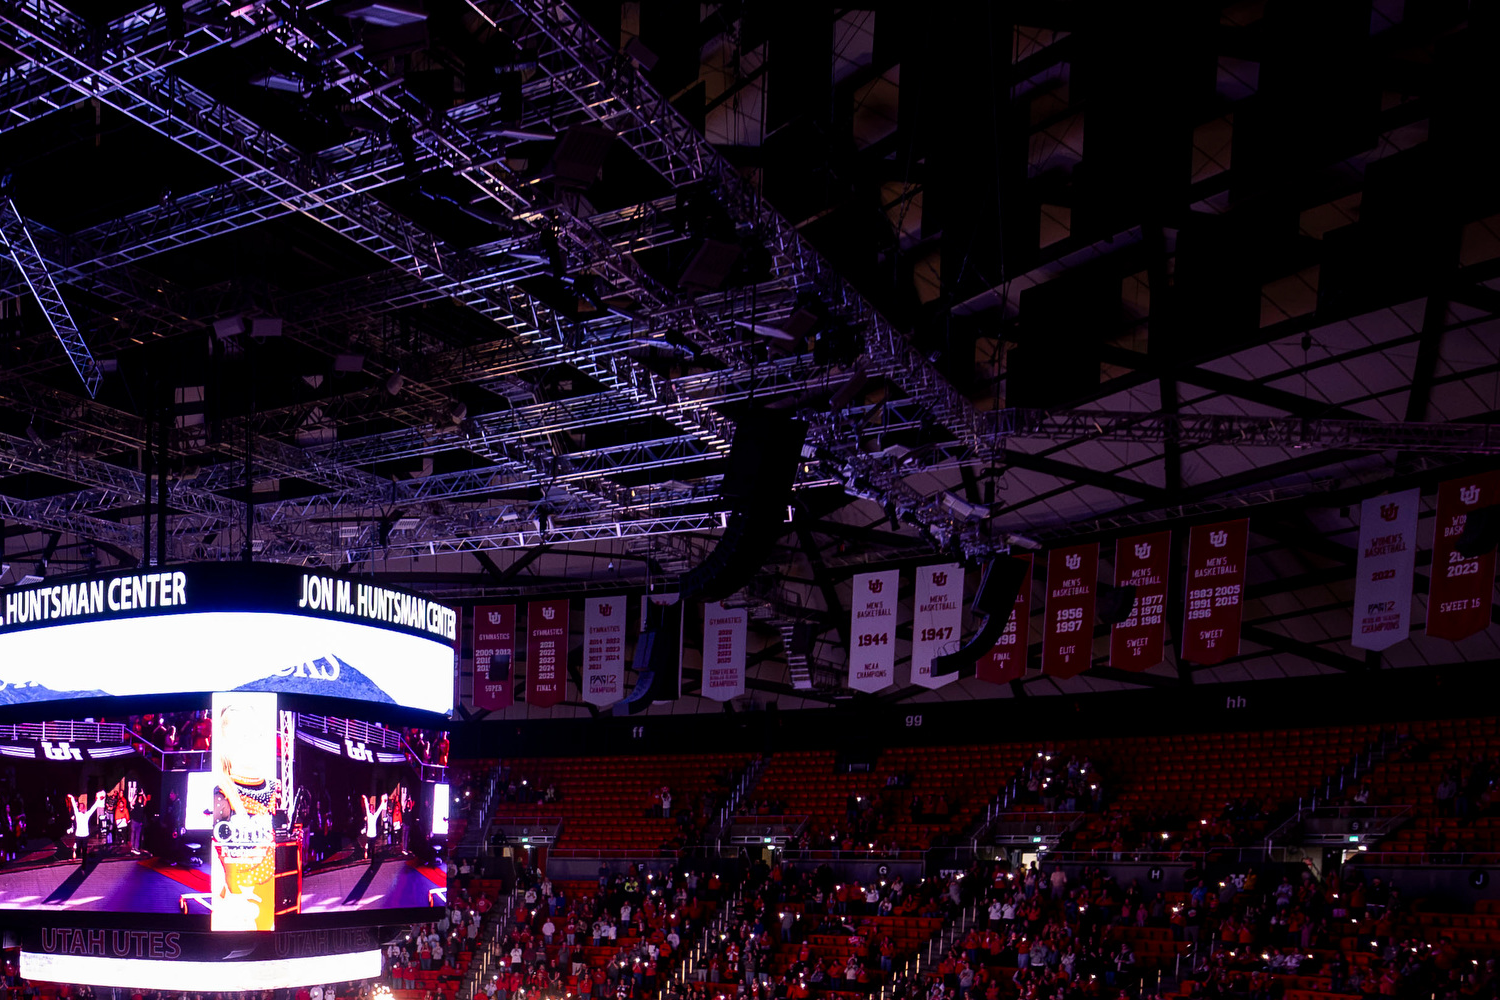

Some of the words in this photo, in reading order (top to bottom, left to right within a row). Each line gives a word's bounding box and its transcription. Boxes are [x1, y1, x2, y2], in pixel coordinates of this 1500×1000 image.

[1371, 533, 1402, 547] WOMEN'S
[1364, 543, 1407, 558] BASKETBALL
[1206, 556, 1228, 567] MEN'S
[1131, 568, 1152, 578] MEN'S
[1194, 564, 1238, 578] BASKETBALL
[1371, 569, 1395, 581] 2023
[1446, 562, 1479, 577] 2023
[1062, 578, 1081, 588] MEN'S
[1120, 576, 1161, 588] BASKETBALL
[1052, 586, 1089, 598] BASKETBALL
[1215, 585, 1240, 596] 2005
[6, 580, 104, 625] HUNTSMAN
[108, 571, 187, 611] CENTER
[930, 594, 948, 603] MEN'S
[1141, 594, 1163, 606] 1977
[1189, 598, 1211, 610] 1991
[1215, 595, 1239, 607] 2015
[299, 574, 334, 611] JON
[336, 580, 355, 614] M.
[357, 583, 426, 630] HUNTSMAN
[426, 601, 456, 641] CENTER
[866, 601, 883, 609] MEN'S
[920, 602, 956, 612] BASKETBALL
[1440, 599, 1468, 613] SWEET
[1471, 598, 1481, 609] 16
[857, 608, 891, 618] BASKETBALL
[1057, 607, 1083, 621] 1956
[1188, 609, 1212, 620] 1996
[709, 617, 742, 625] GYMNASTICS
[1056, 620, 1083, 633] 1997
[532, 628, 563, 636] GYMNASTICS
[589, 626, 620, 634] GYMNASTICS
[1361, 621, 1400, 634] CHAMPIONS
[479, 633, 510, 641] GYMNASTICS
[858, 633, 888, 646] 1944
[921, 627, 953, 641] 1947
[1200, 629, 1224, 640] SWEET
[1127, 637, 1148, 648] SWEET
[1207, 639, 1215, 649] 16
[1059, 645, 1076, 655] ELITE
[1132, 647, 1141, 656] 16
[993, 652, 1011, 661] FINAL
[864, 662, 879, 670] NCAA
[999, 661, 1004, 669] 4
[857, 670, 887, 679] CHAMPIONS
[1226, 695, 1247, 709] hh
[905, 714, 923, 727] gg
[632, 726, 644, 738] ff
[879, 866, 887, 875] G
[1151, 870, 1161, 879] H
[1476, 873, 1484, 886] J
[41, 928, 106, 955] UTAH
[112, 930, 181, 959] UTES
